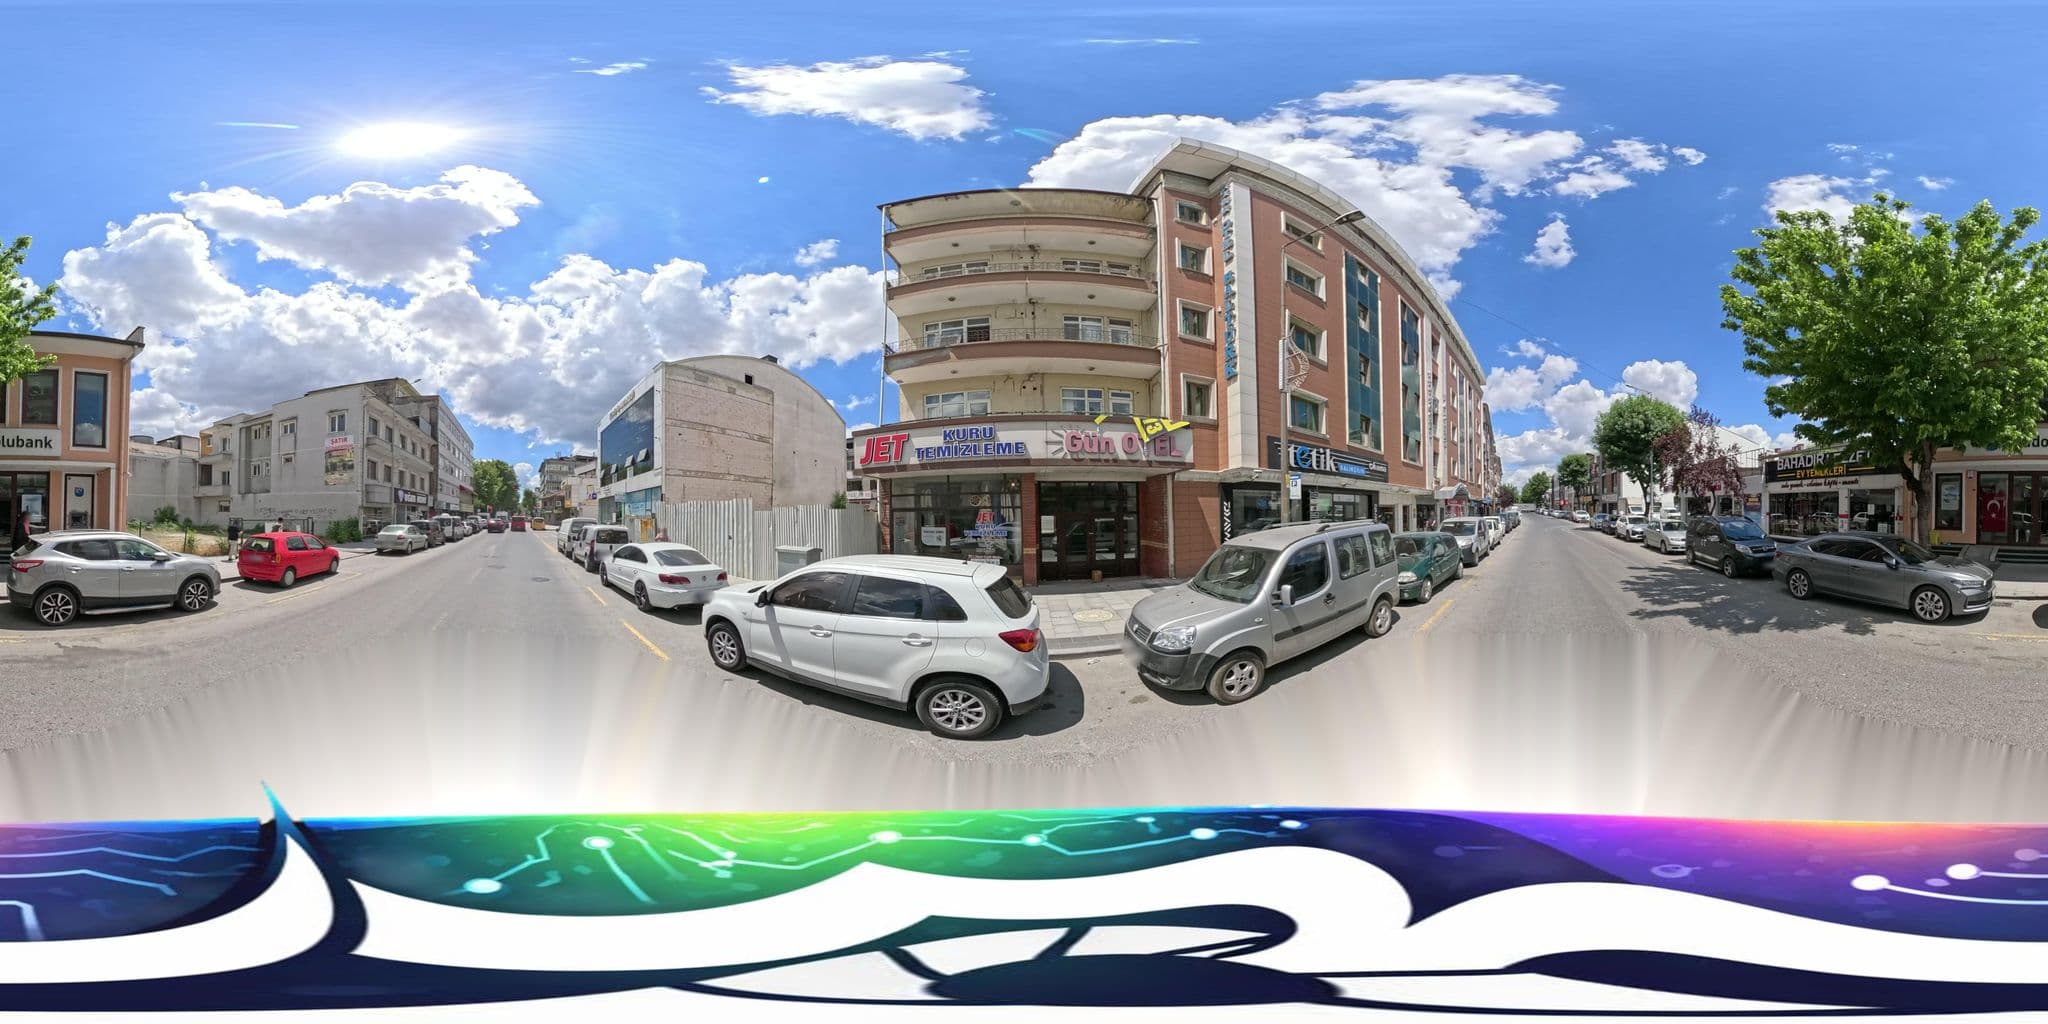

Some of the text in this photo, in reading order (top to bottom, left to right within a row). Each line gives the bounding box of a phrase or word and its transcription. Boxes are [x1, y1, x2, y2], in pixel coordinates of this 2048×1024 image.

[0, 436, 53, 448] lubank
[943, 426, 995, 441] KURU
[1065, 430, 1116, 454] Gün
[860, 433, 908, 465] JET
[915, 441, 1025, 461] TEMİZLEME
[1288, 444, 1338, 472] tetik
[1777, 453, 1825, 470] BAHADIR
[976, 511, 994, 522] JET
